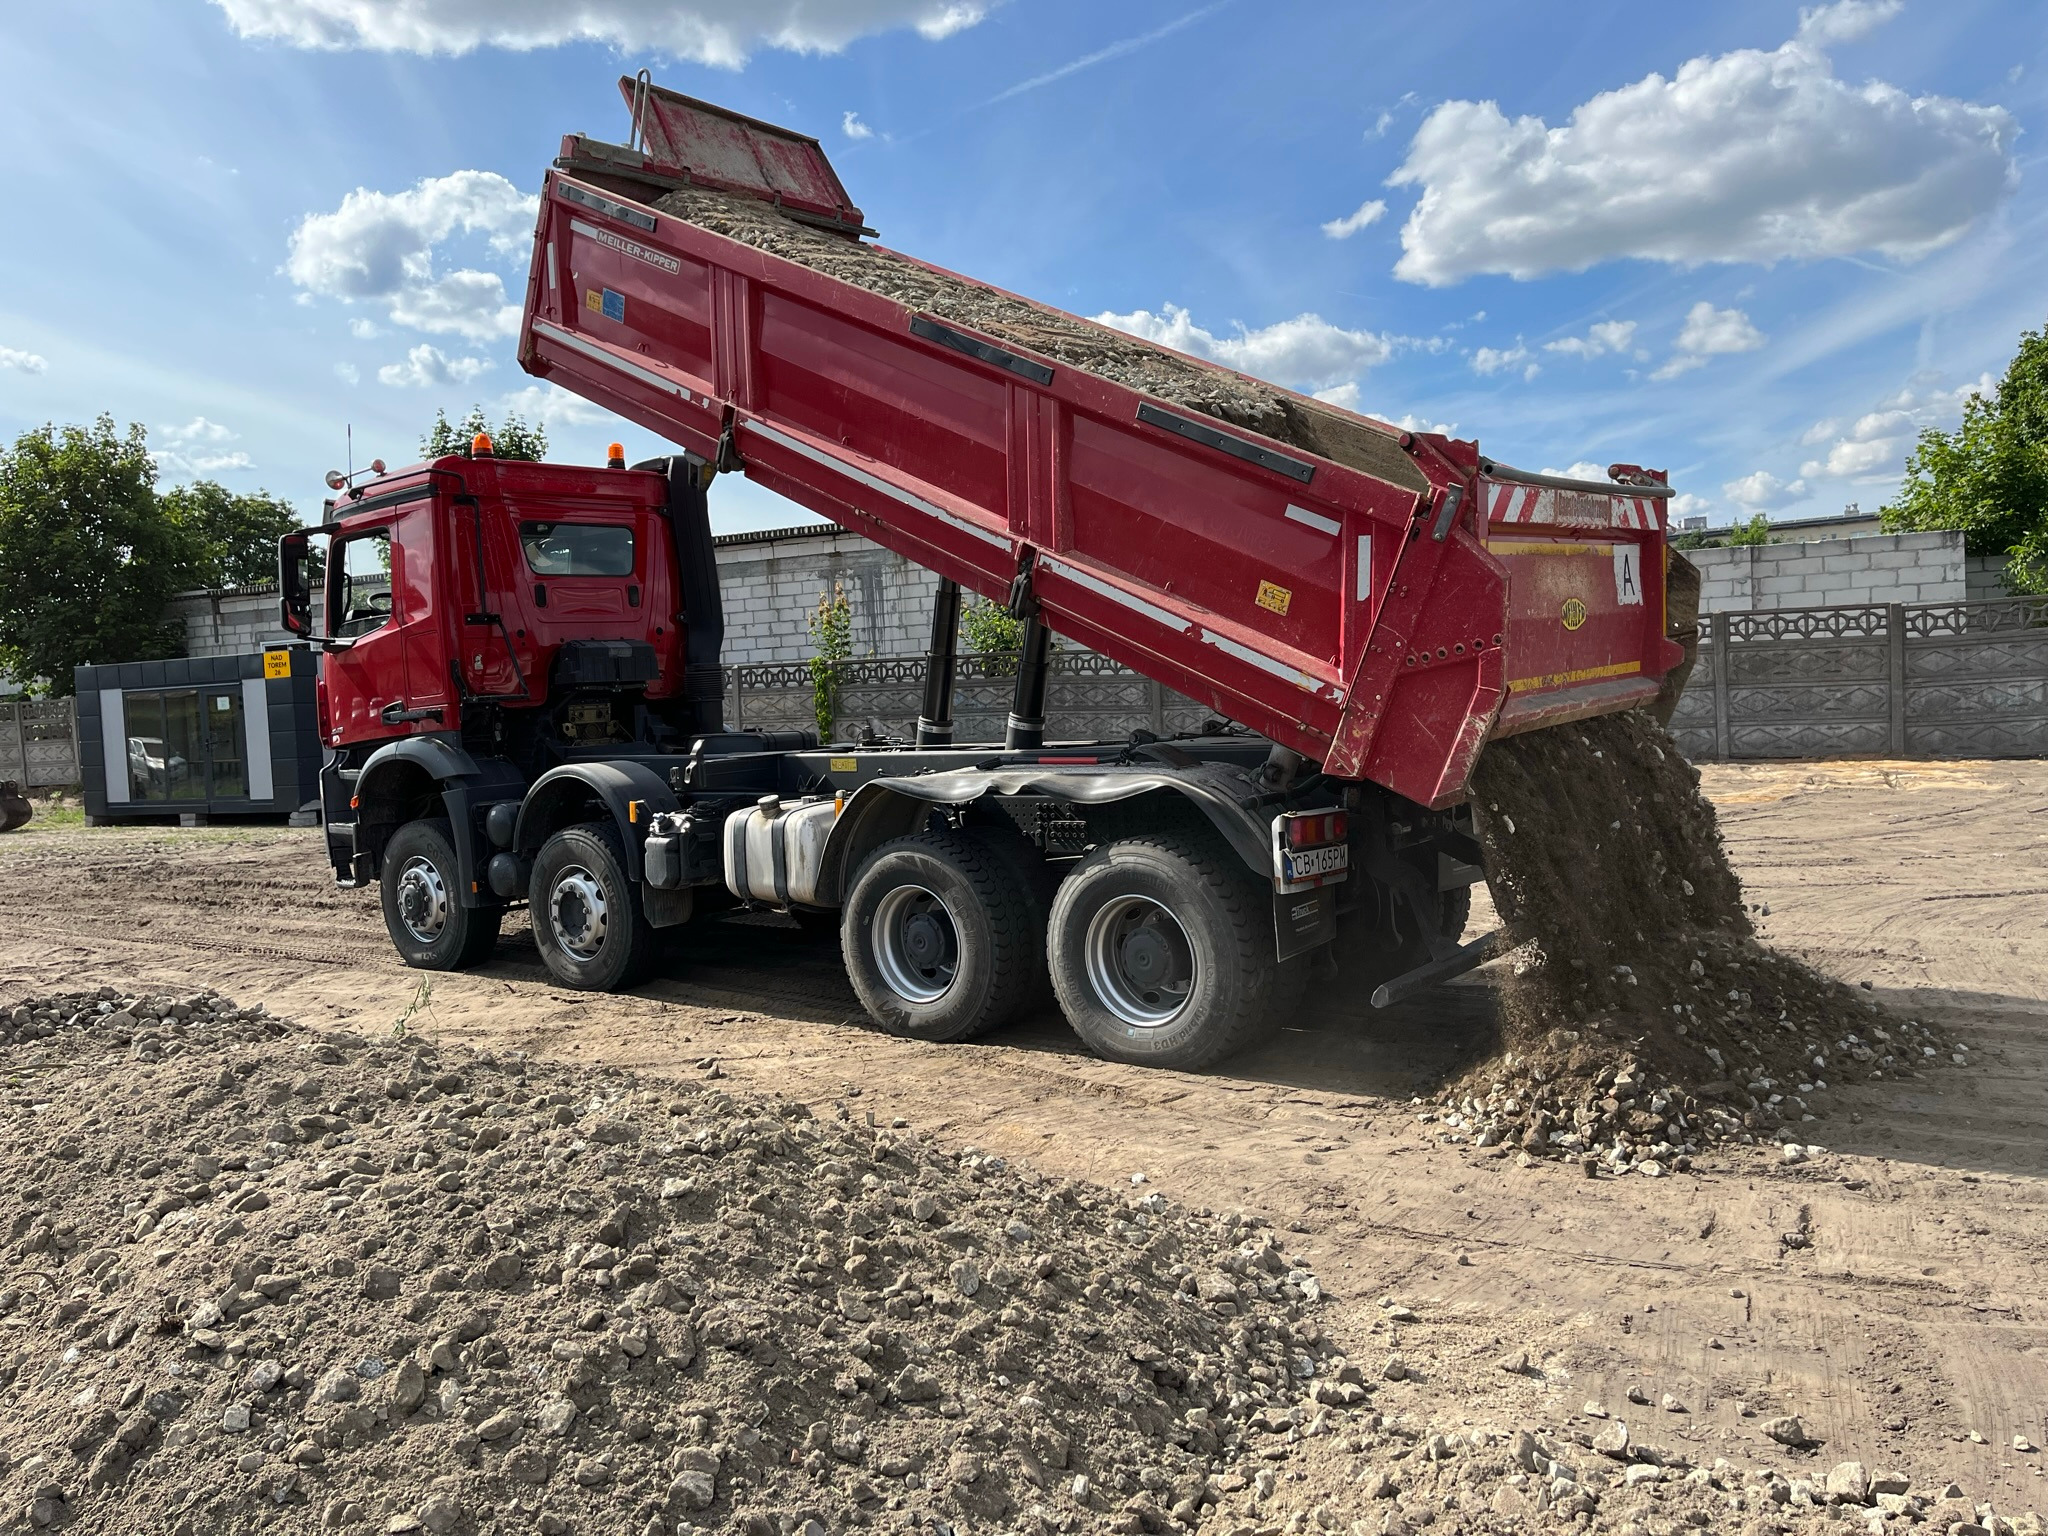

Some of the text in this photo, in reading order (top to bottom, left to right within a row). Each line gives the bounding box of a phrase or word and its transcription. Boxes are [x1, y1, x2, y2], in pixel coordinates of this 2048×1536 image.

[598, 232, 678, 271] MEILLER-KIPPER
[1623, 553, 1636, 596] A
[1295, 854, 1312, 876] CB
[1315, 848, 1346, 871] 165PM
